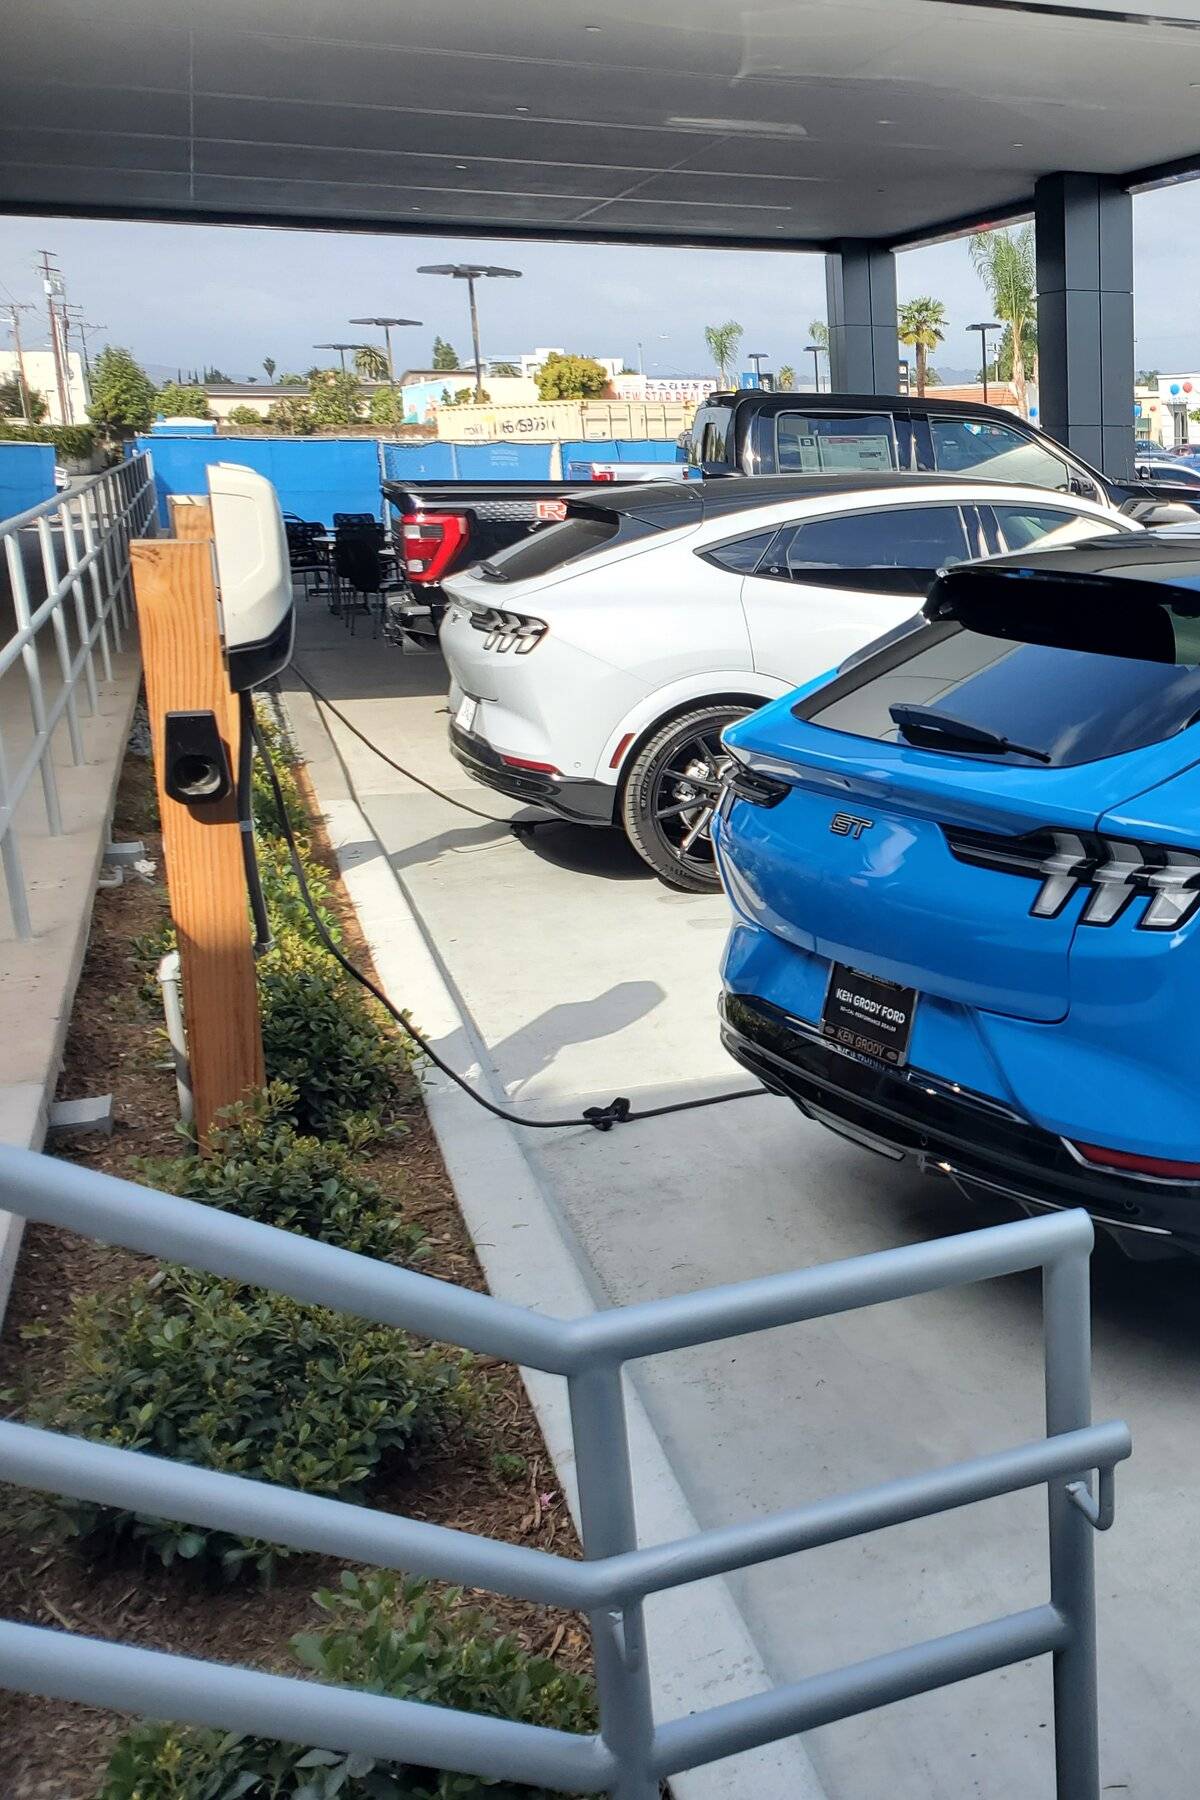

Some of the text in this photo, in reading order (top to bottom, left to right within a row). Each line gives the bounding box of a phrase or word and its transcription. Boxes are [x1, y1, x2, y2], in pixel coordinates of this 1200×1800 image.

[836, 988, 906, 1023] KEN GRODY FORD
[836, 1029, 855, 1044] KEN
[855, 1035, 885, 1057] GRODY
